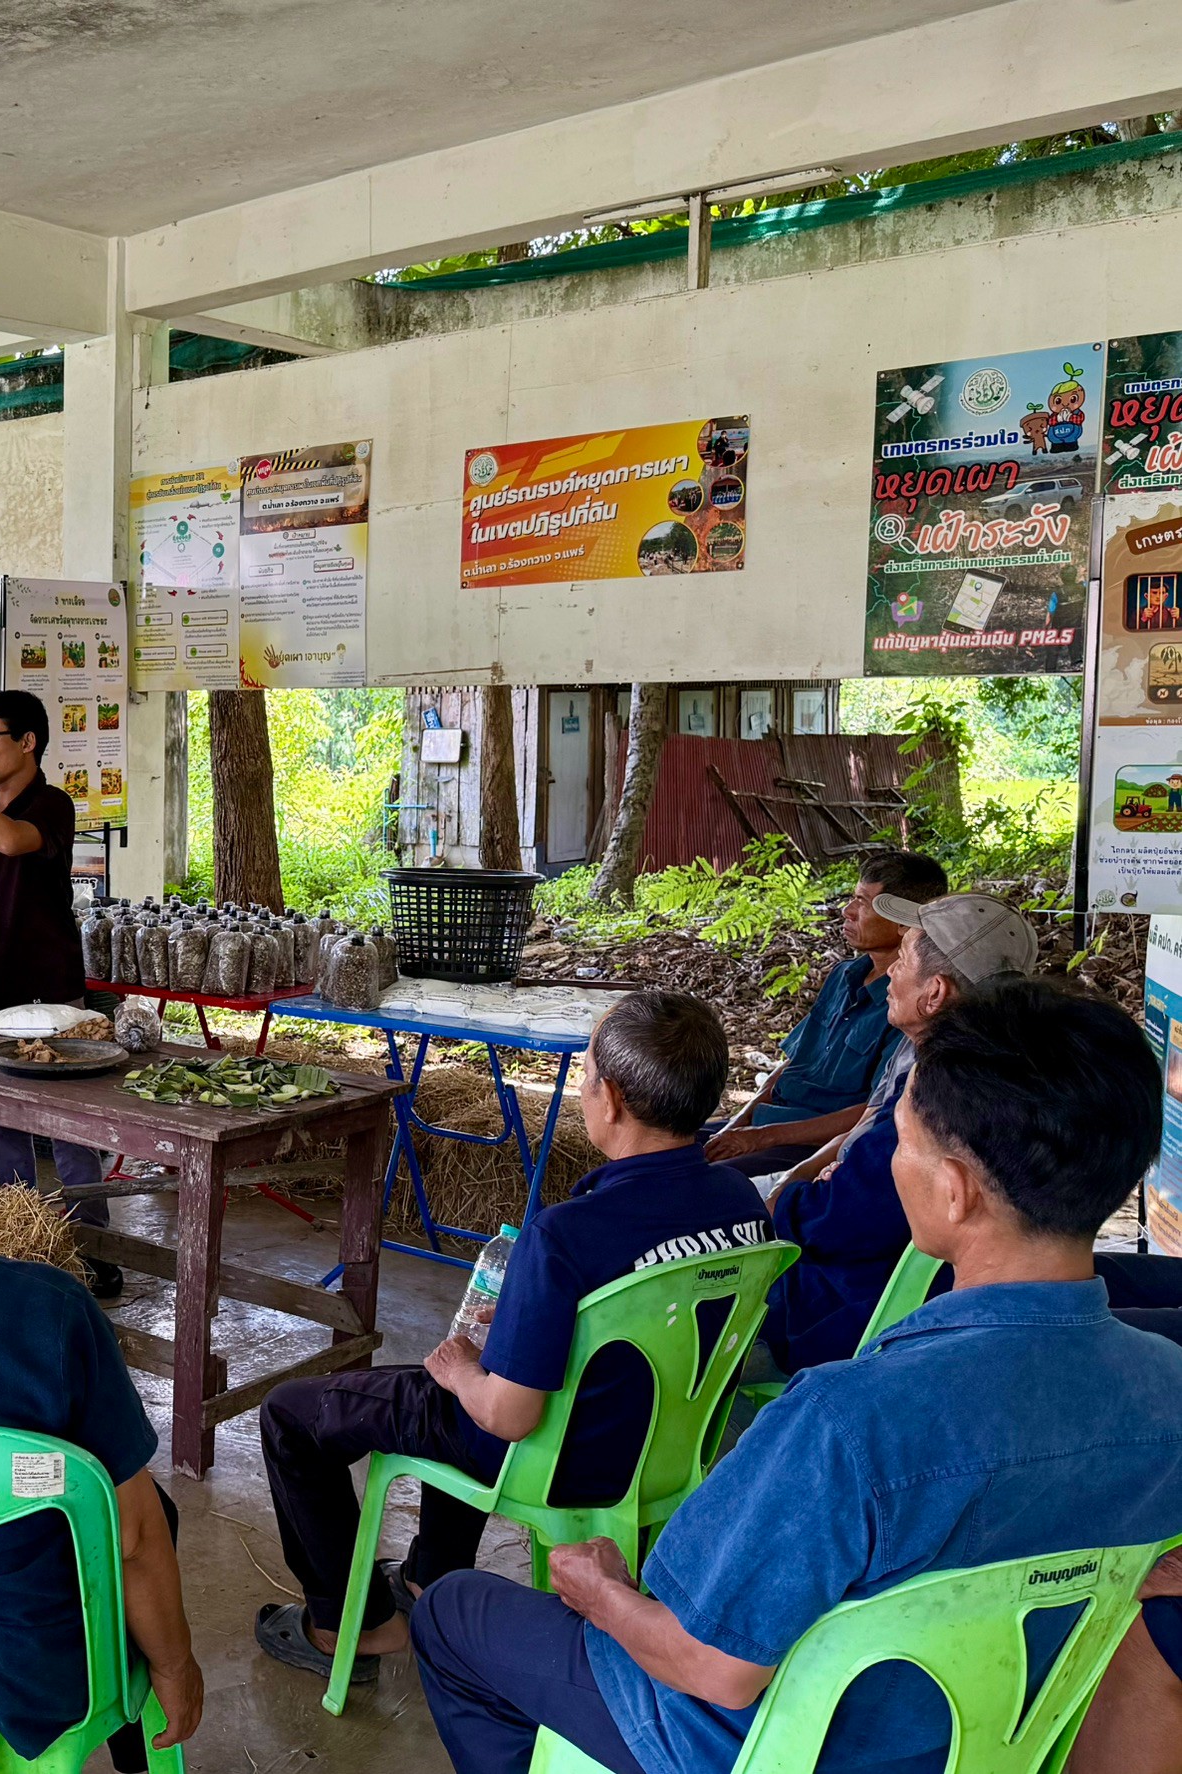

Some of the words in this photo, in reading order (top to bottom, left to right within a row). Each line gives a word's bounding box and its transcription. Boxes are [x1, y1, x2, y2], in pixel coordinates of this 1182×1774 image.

[882, 428, 1019, 458] เกษตรกรร่วมใจ
[469, 453, 689, 518] ศูนย์รณรงค์หยุดการเผา
[874, 461, 1020, 514] หยุดเผา
[470, 494, 618, 544] ในเขตปฏิรูปที่ดิน
[917, 503, 1071, 554] เฝ้าระวัง
[500, 554, 552, 571] อ.ร้องกวาง
[555, 544, 585, 561] จ.แพร่
[884, 549, 1071, 573] ส่งเสริมการทำเกษตรกรรมยั่งยืน
[874, 631, 1016, 653] แก้ปัญหาฝุ่นควันพิษ
[1019, 628, 1074, 646] PM2.5
[1029, 1560, 1097, 1585] บ้านบุญแจ่ม
